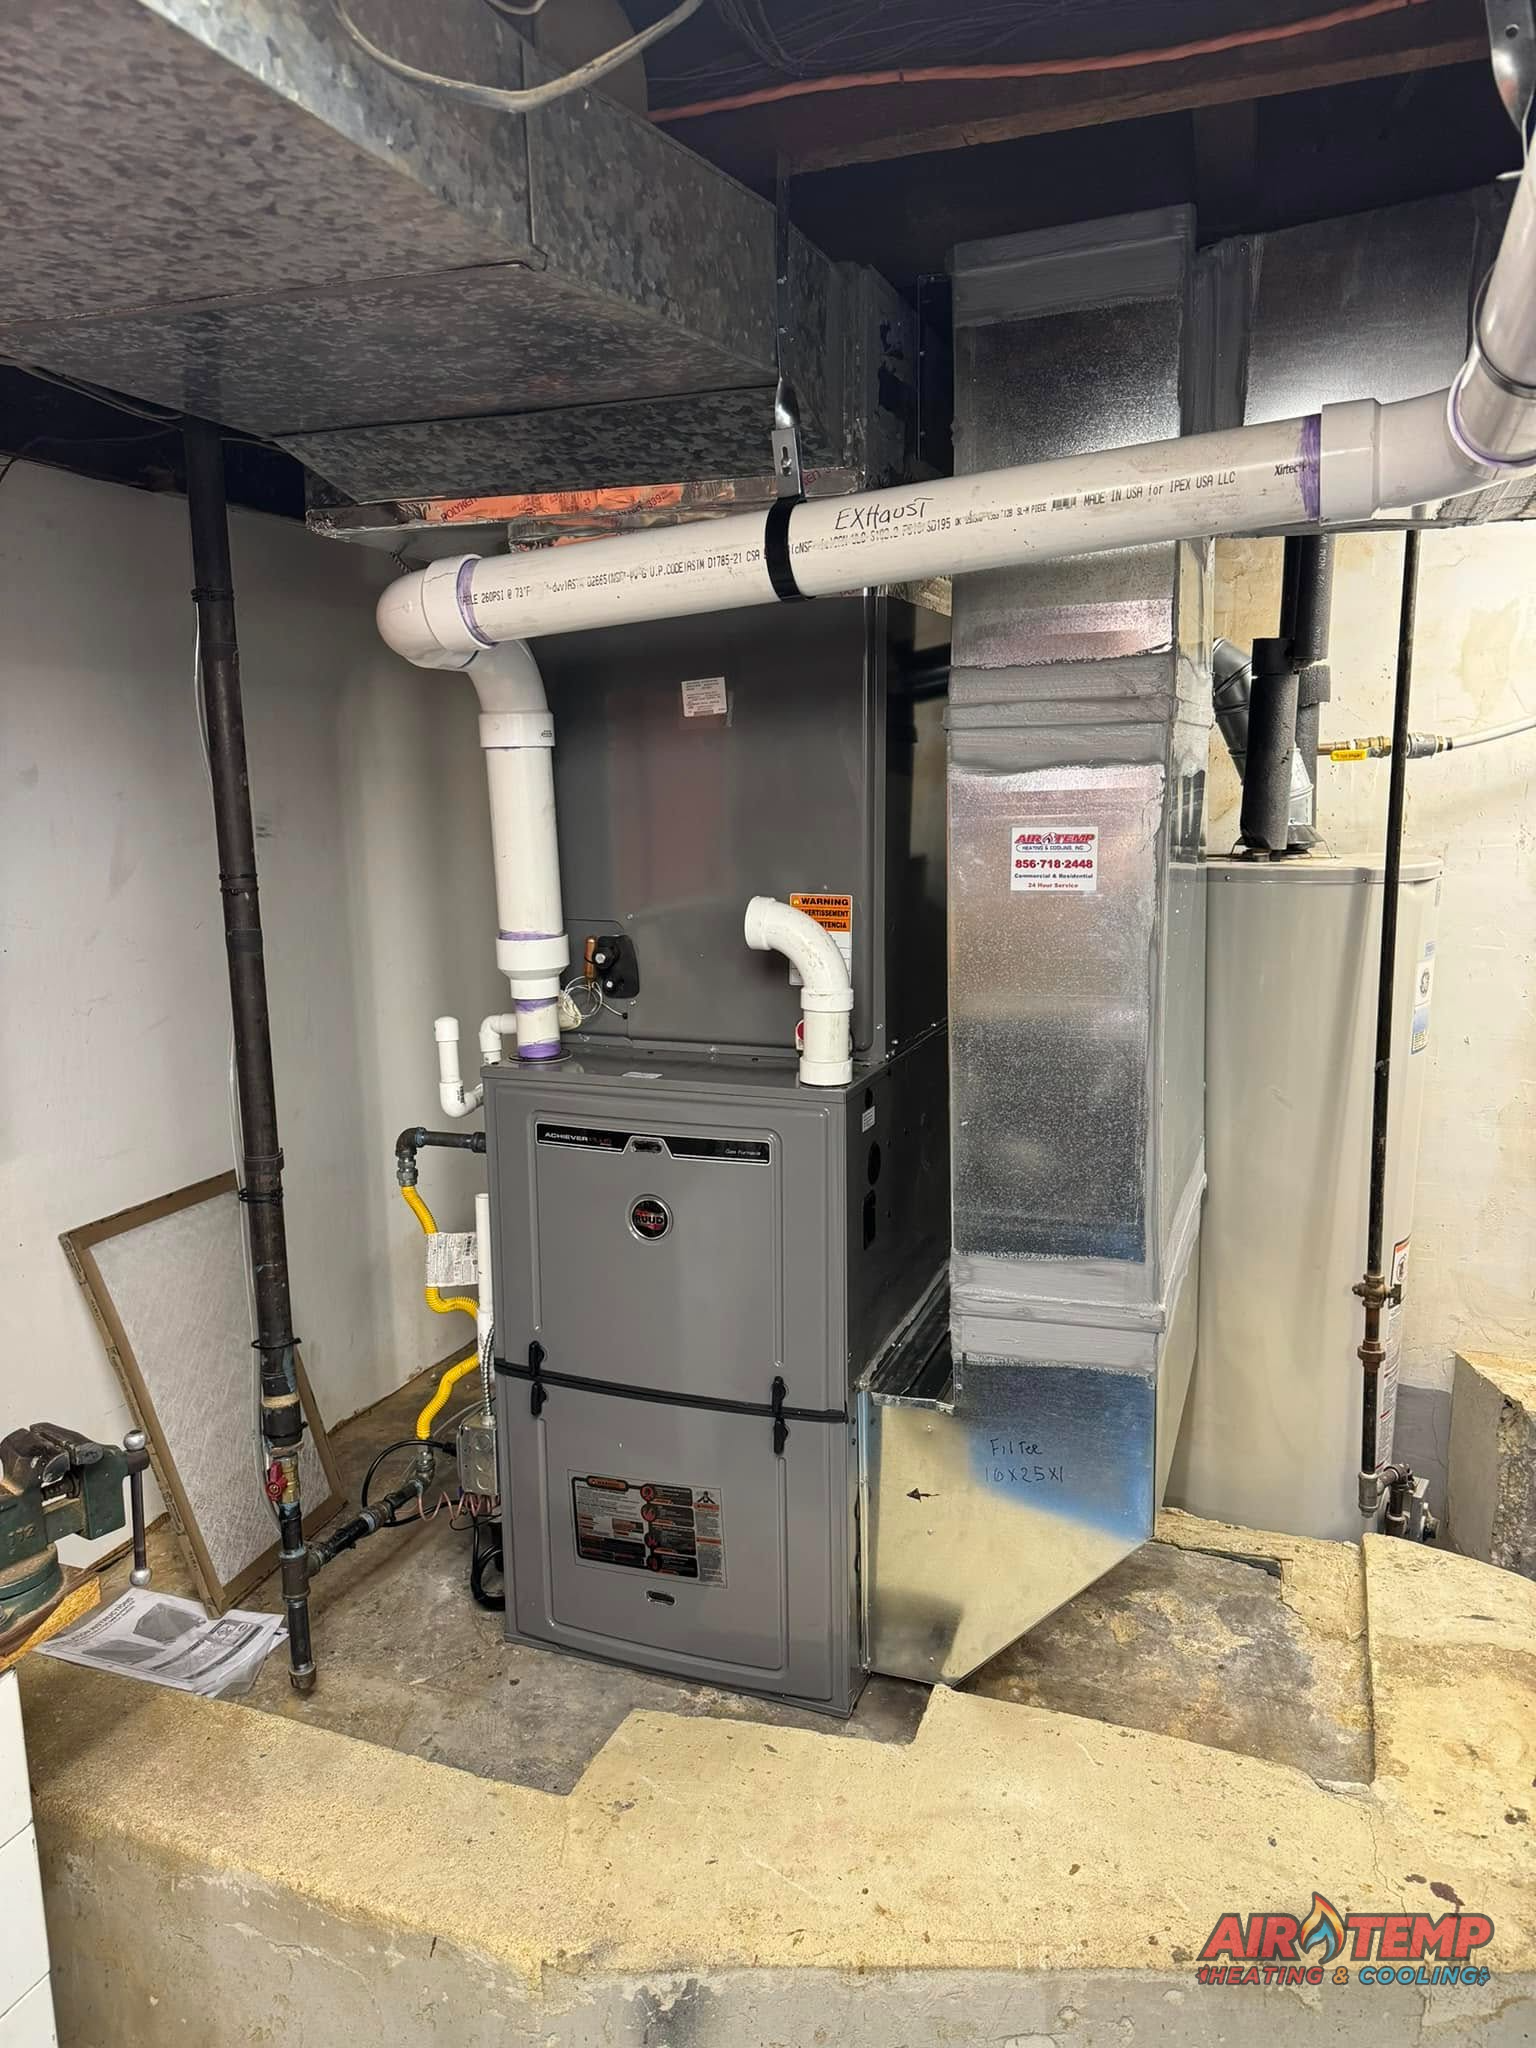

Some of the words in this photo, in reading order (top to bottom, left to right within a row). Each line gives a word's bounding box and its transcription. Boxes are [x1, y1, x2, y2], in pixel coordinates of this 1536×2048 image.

[1083, 491, 1106, 506] MADE
[1111, 489, 1122, 502] IN
[1126, 486, 1143, 499] USA
[1148, 484, 1164, 497] for
[1169, 478, 1191, 493] IPEX
[1196, 475, 1214, 489] USA
[1218, 471, 1236, 486] LLC
[1014, 834, 1041, 844] AIR
[1054, 833, 1096, 844] TEMP
[801, 897, 849, 906] WARNING
[544, 1131, 589, 1142] ACHIEVER
